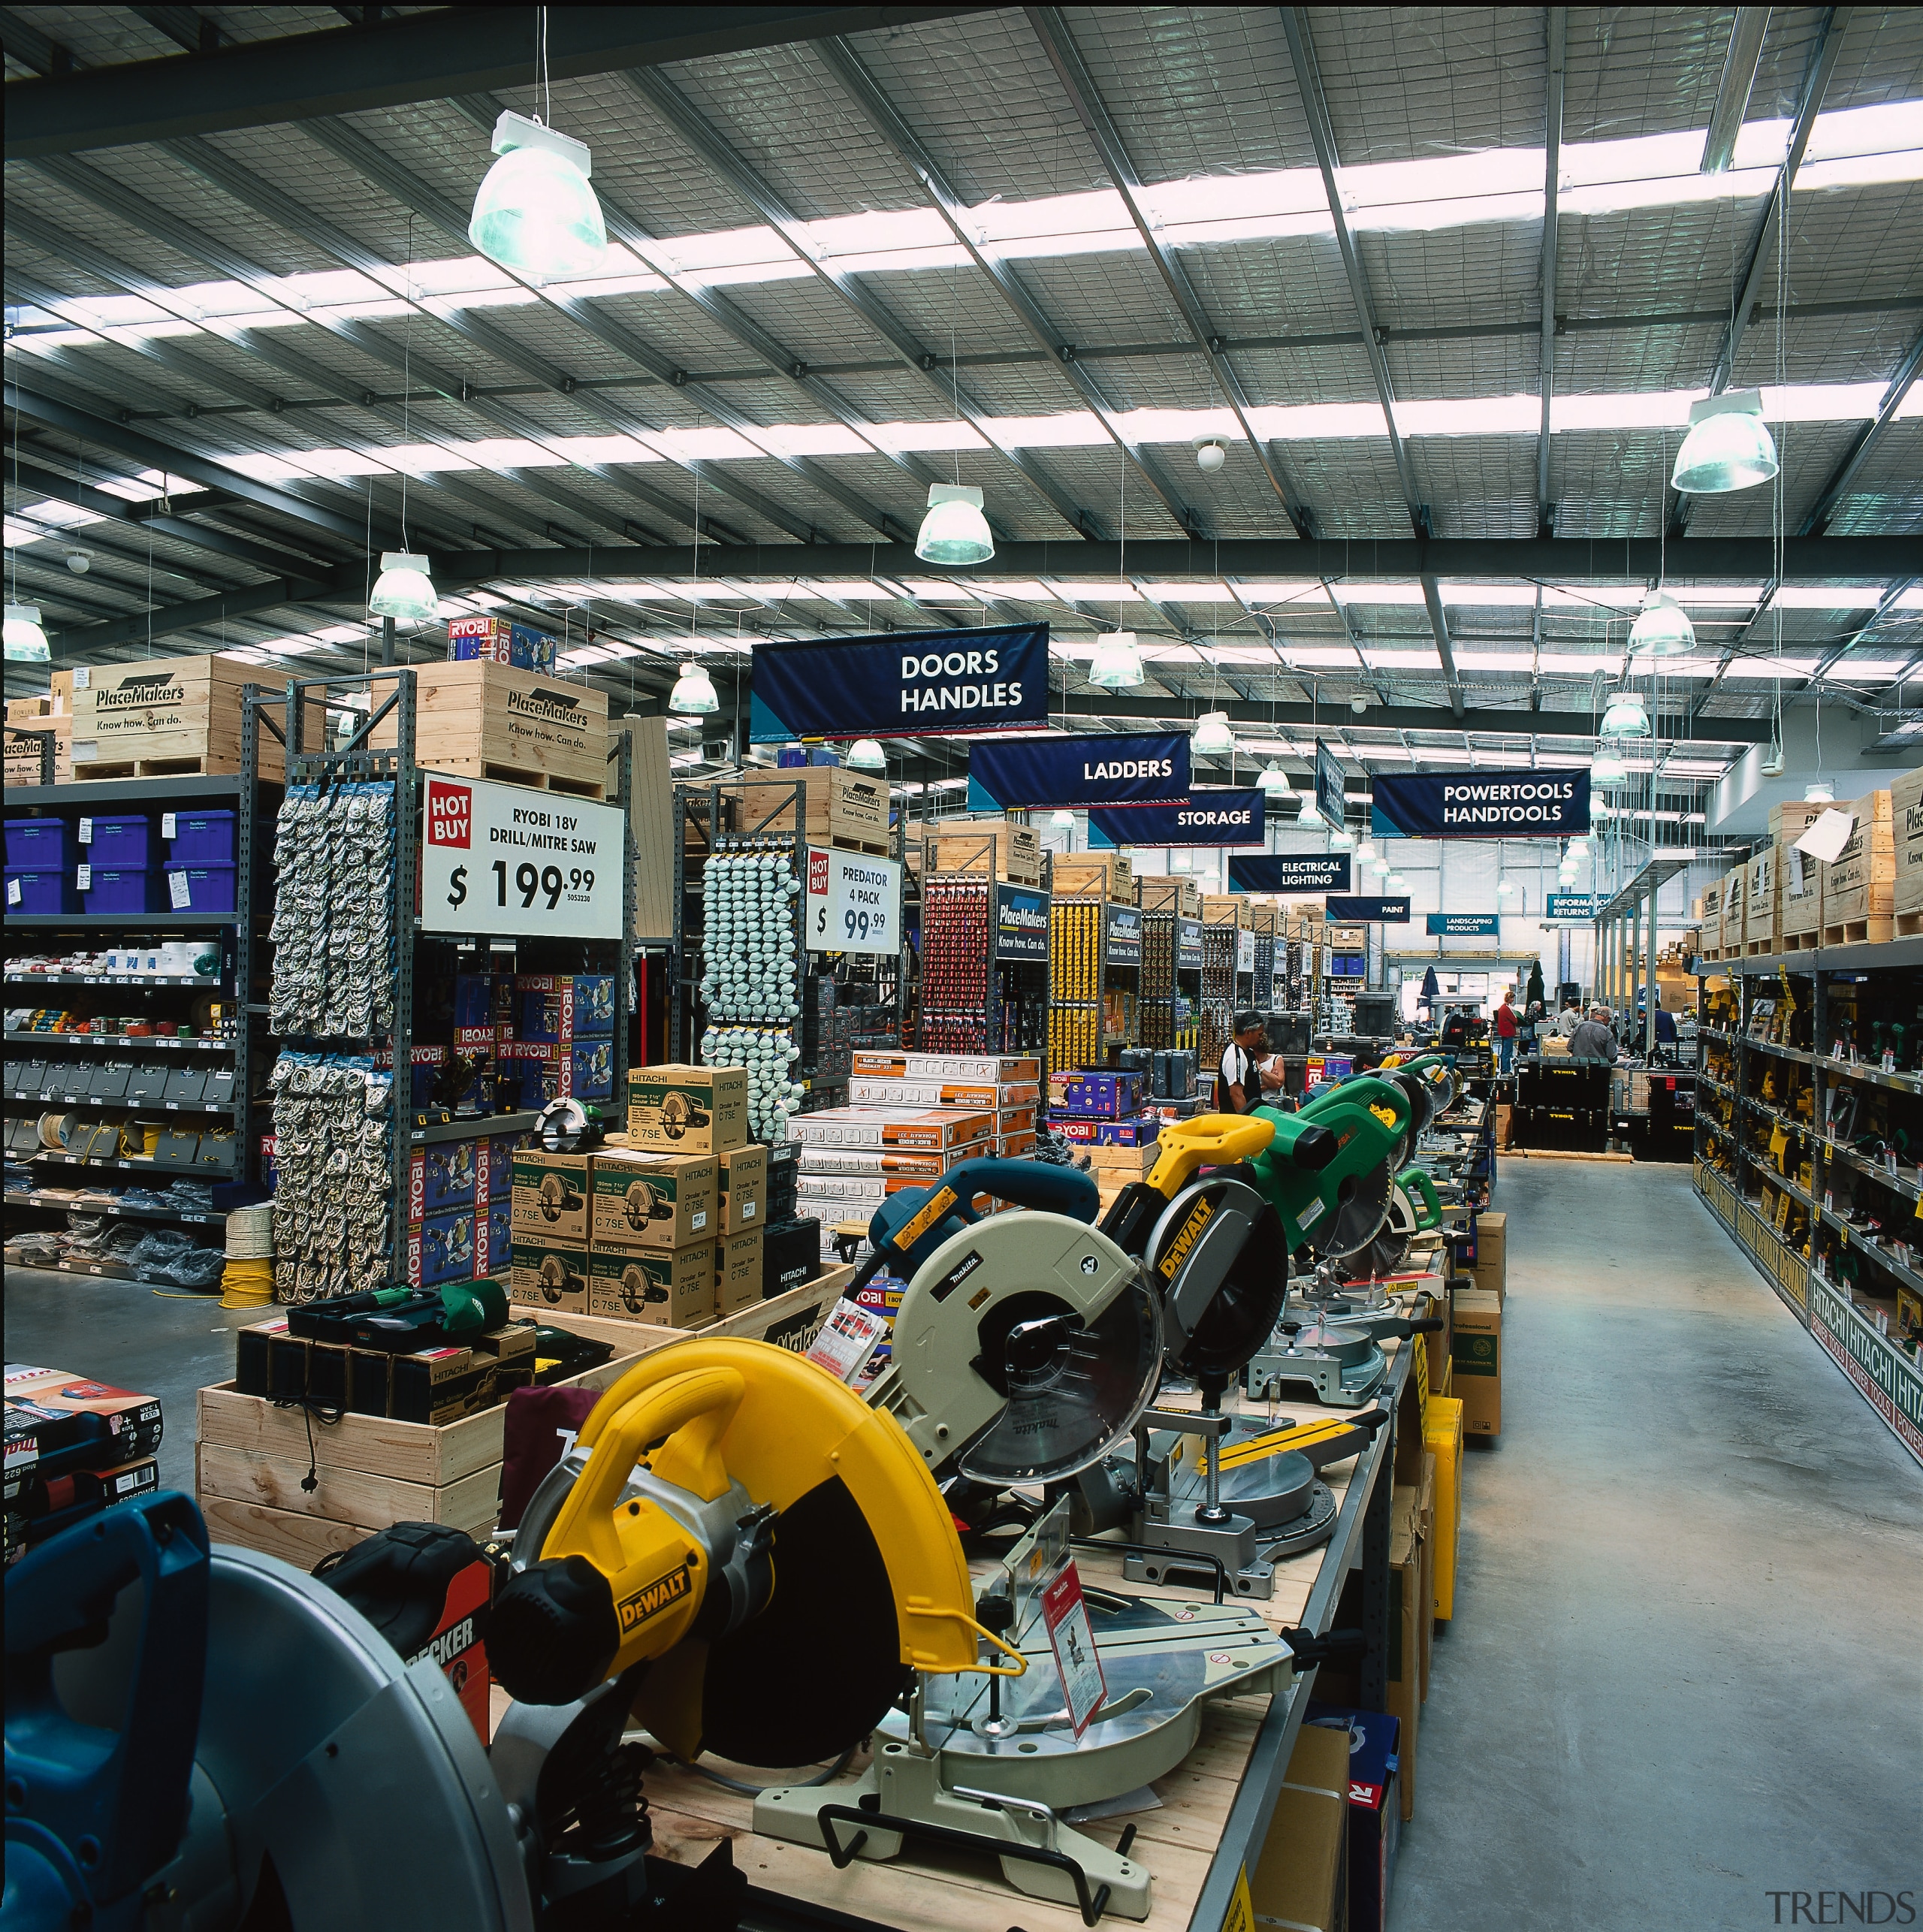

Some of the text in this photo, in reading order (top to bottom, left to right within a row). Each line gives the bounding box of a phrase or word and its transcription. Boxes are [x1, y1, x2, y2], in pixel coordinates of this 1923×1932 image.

[451, 620, 488, 636] RYOBI
[902, 650, 998, 679] DOORS
[96, 684, 184, 707] PlaceMakers
[901, 682, 1022, 712] HANDLES
[507, 691, 588, 726] PlaceMakers
[97, 714, 182, 730] Know how. Can do.
[508, 722, 587, 750] Know how. Can do.
[1084, 759, 1173, 780] LADDERS
[842, 787, 880, 808] PlaceMakers
[1444, 783, 1573, 801] POWERTOOLS
[432, 795, 468, 817] HOT
[842, 808, 854, 817] Know
[513, 808, 578, 832] RYOBI 18V
[1177, 811, 1251, 826] STORAGE
[1444, 805, 1562, 823] HANDTOOLS
[434, 818, 469, 840] BUY
[490, 827, 596, 855] DRILL/MITRE SAW
[811, 859, 828, 874] HOT
[1282, 862, 1341, 872] ELECTRICAL
[812, 875, 828, 890] BUY
[843, 866, 887, 886] PREDATOR
[1282, 874, 1333, 885] LIGHTING
[447, 865, 468, 912] $
[850, 889, 880, 905] 4 PACK
[817, 905, 886, 940] $ 99.99
[1000, 904, 1047, 928] PlaceMakers
[1109, 921, 1140, 938] PlaceMakers
[998, 935, 1046, 950] Know how. Can do.
[517, 979, 553, 990] RYOBI
[561, 988, 572, 1040] RYOBI
[462, 1028, 494, 1043] RYOBI
[515, 1044, 551, 1058] RYOBI
[632, 1074, 668, 1083] HITACHI
[719, 1081, 743, 1091] HITACHI
[719, 1110, 735, 1121] C 7SE
[631, 1128, 660, 1139] C 7SE
[515, 1155, 545, 1164] HITACHI
[597, 1162, 633, 1172] HITACHI
[736, 1158, 762, 1172] HITACHI
[477, 1150, 488, 1205] RYOBI
[684, 1167, 713, 1182] HITACHI
[411, 1161, 424, 1220] RYOBI
[736, 1182, 750, 1190] Circular
[684, 1191, 700, 1201] Circular
[736, 1189, 753, 1201] C 7SE
[684, 1199, 705, 1212] C 7SE
[513, 1208, 539, 1221] C 7SE
[595, 1217, 624, 1229] C 7SE
[513, 1236, 546, 1245] HITACHI
[732, 1236, 758, 1251] HITACHI
[476, 1221, 488, 1276] RYOBI
[592, 1244, 627, 1254] HITACHI
[680, 1248, 709, 1265] HITACHI
[732, 1257, 756, 1269] Circular Saw
[680, 1273, 696, 1283] Circular
[731, 1266, 750, 1280] C 7SE
[780, 1266, 807, 1283] HITACHI
[1780, 1250, 1807, 1300] DEWALT
[512, 1289, 539, 1301] C 7SE
[679, 1280, 700, 1295] C 7SE
[592, 1300, 620, 1312] C 7SE
[1813, 1282, 1846, 1341] HITACHI
[1813, 1316, 1845, 1363] POWER TOOLS
[1850, 1321, 1891, 1392] HITACHI
[433, 1363, 469, 1382] HITACHI
[1849, 1359, 1891, 1417] POWER TOOLS
